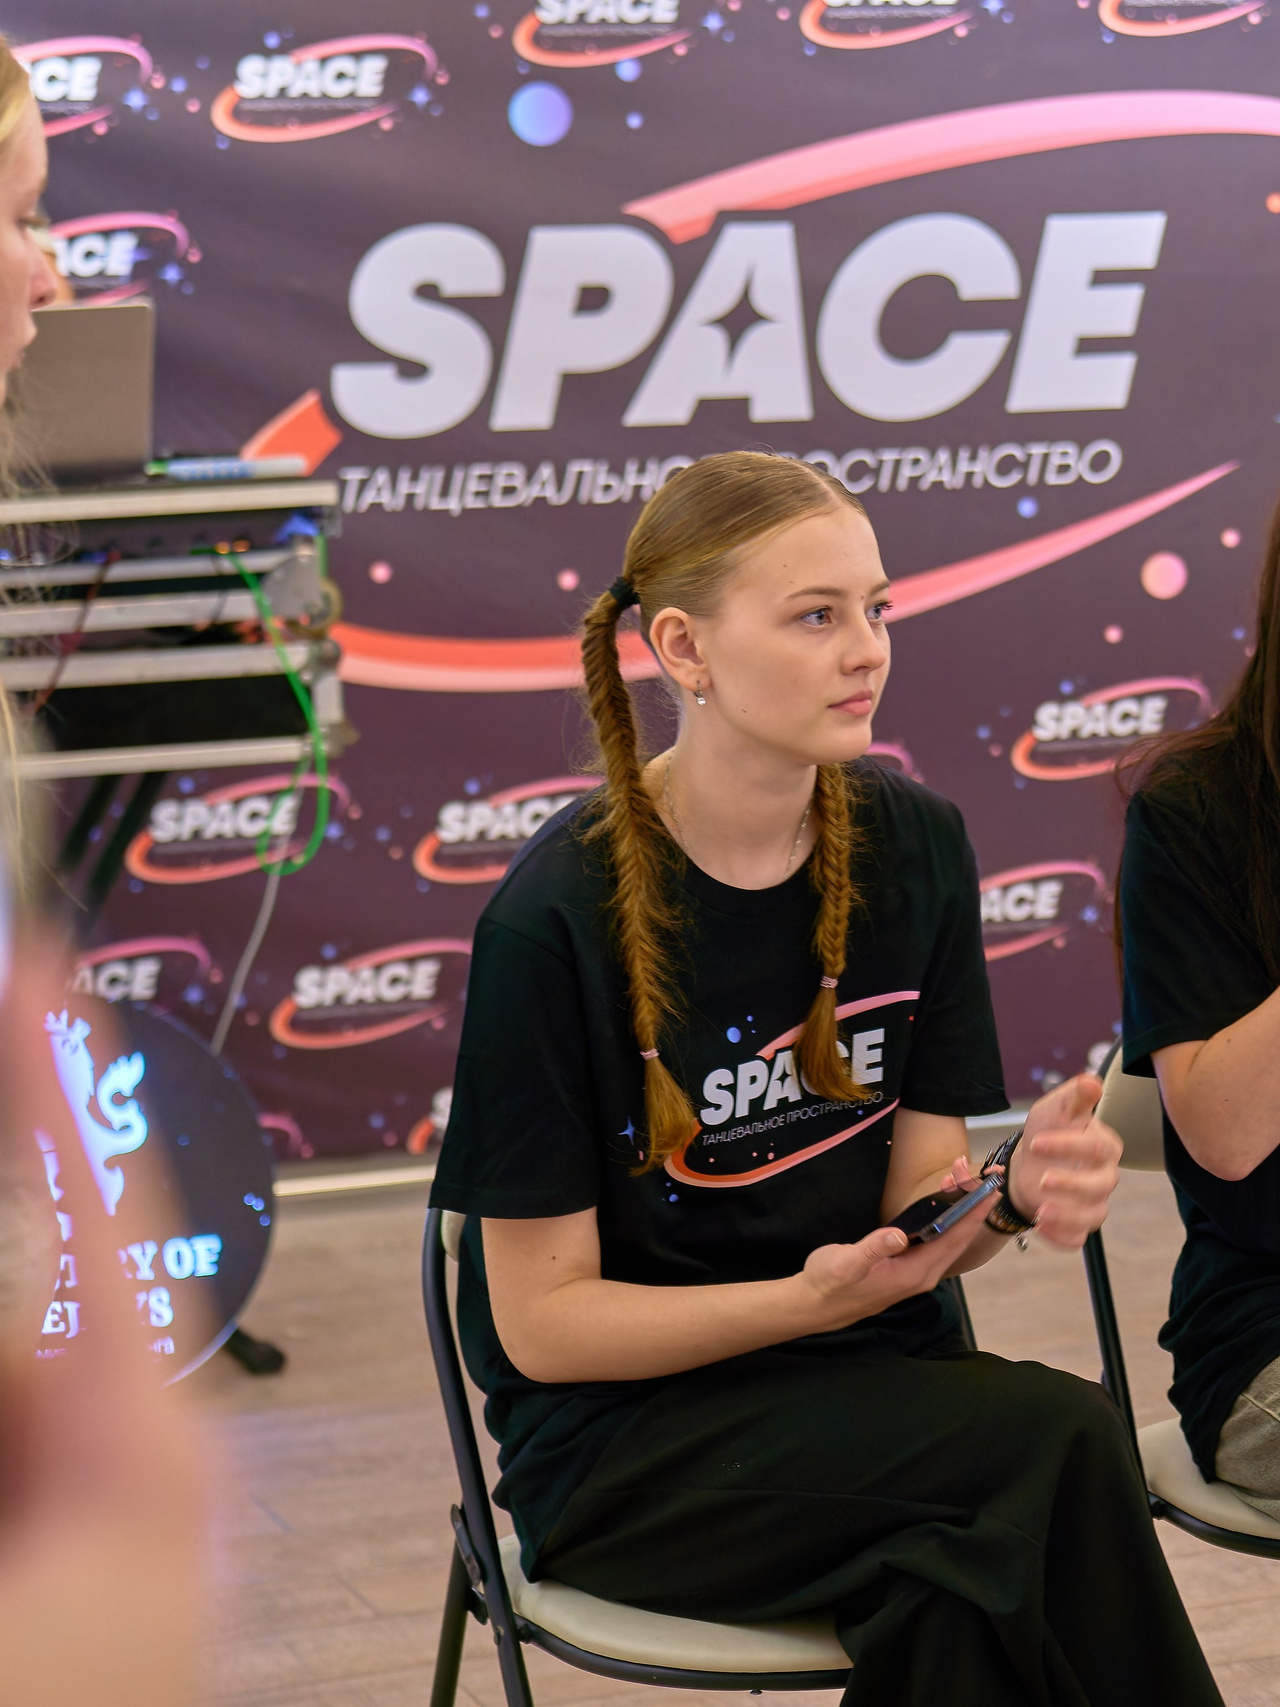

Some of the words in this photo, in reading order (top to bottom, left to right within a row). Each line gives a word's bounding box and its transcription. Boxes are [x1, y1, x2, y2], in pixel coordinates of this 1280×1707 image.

[235, 55, 389, 99] SPACE
[331, 211, 1168, 440] SPACE
[338, 454, 717, 517] ТАНЦЕВАЛЬНО
[1031, 696, 1168, 742] SPACE
[149, 797, 299, 843] SPACE
[436, 797, 575, 843] SPAC
[980, 880, 1063, 923] ACE
[294, 957, 441, 1009] SPACE
[702, 1114, 785, 1146] ТАНЦЕВАЛЬНОЕ
